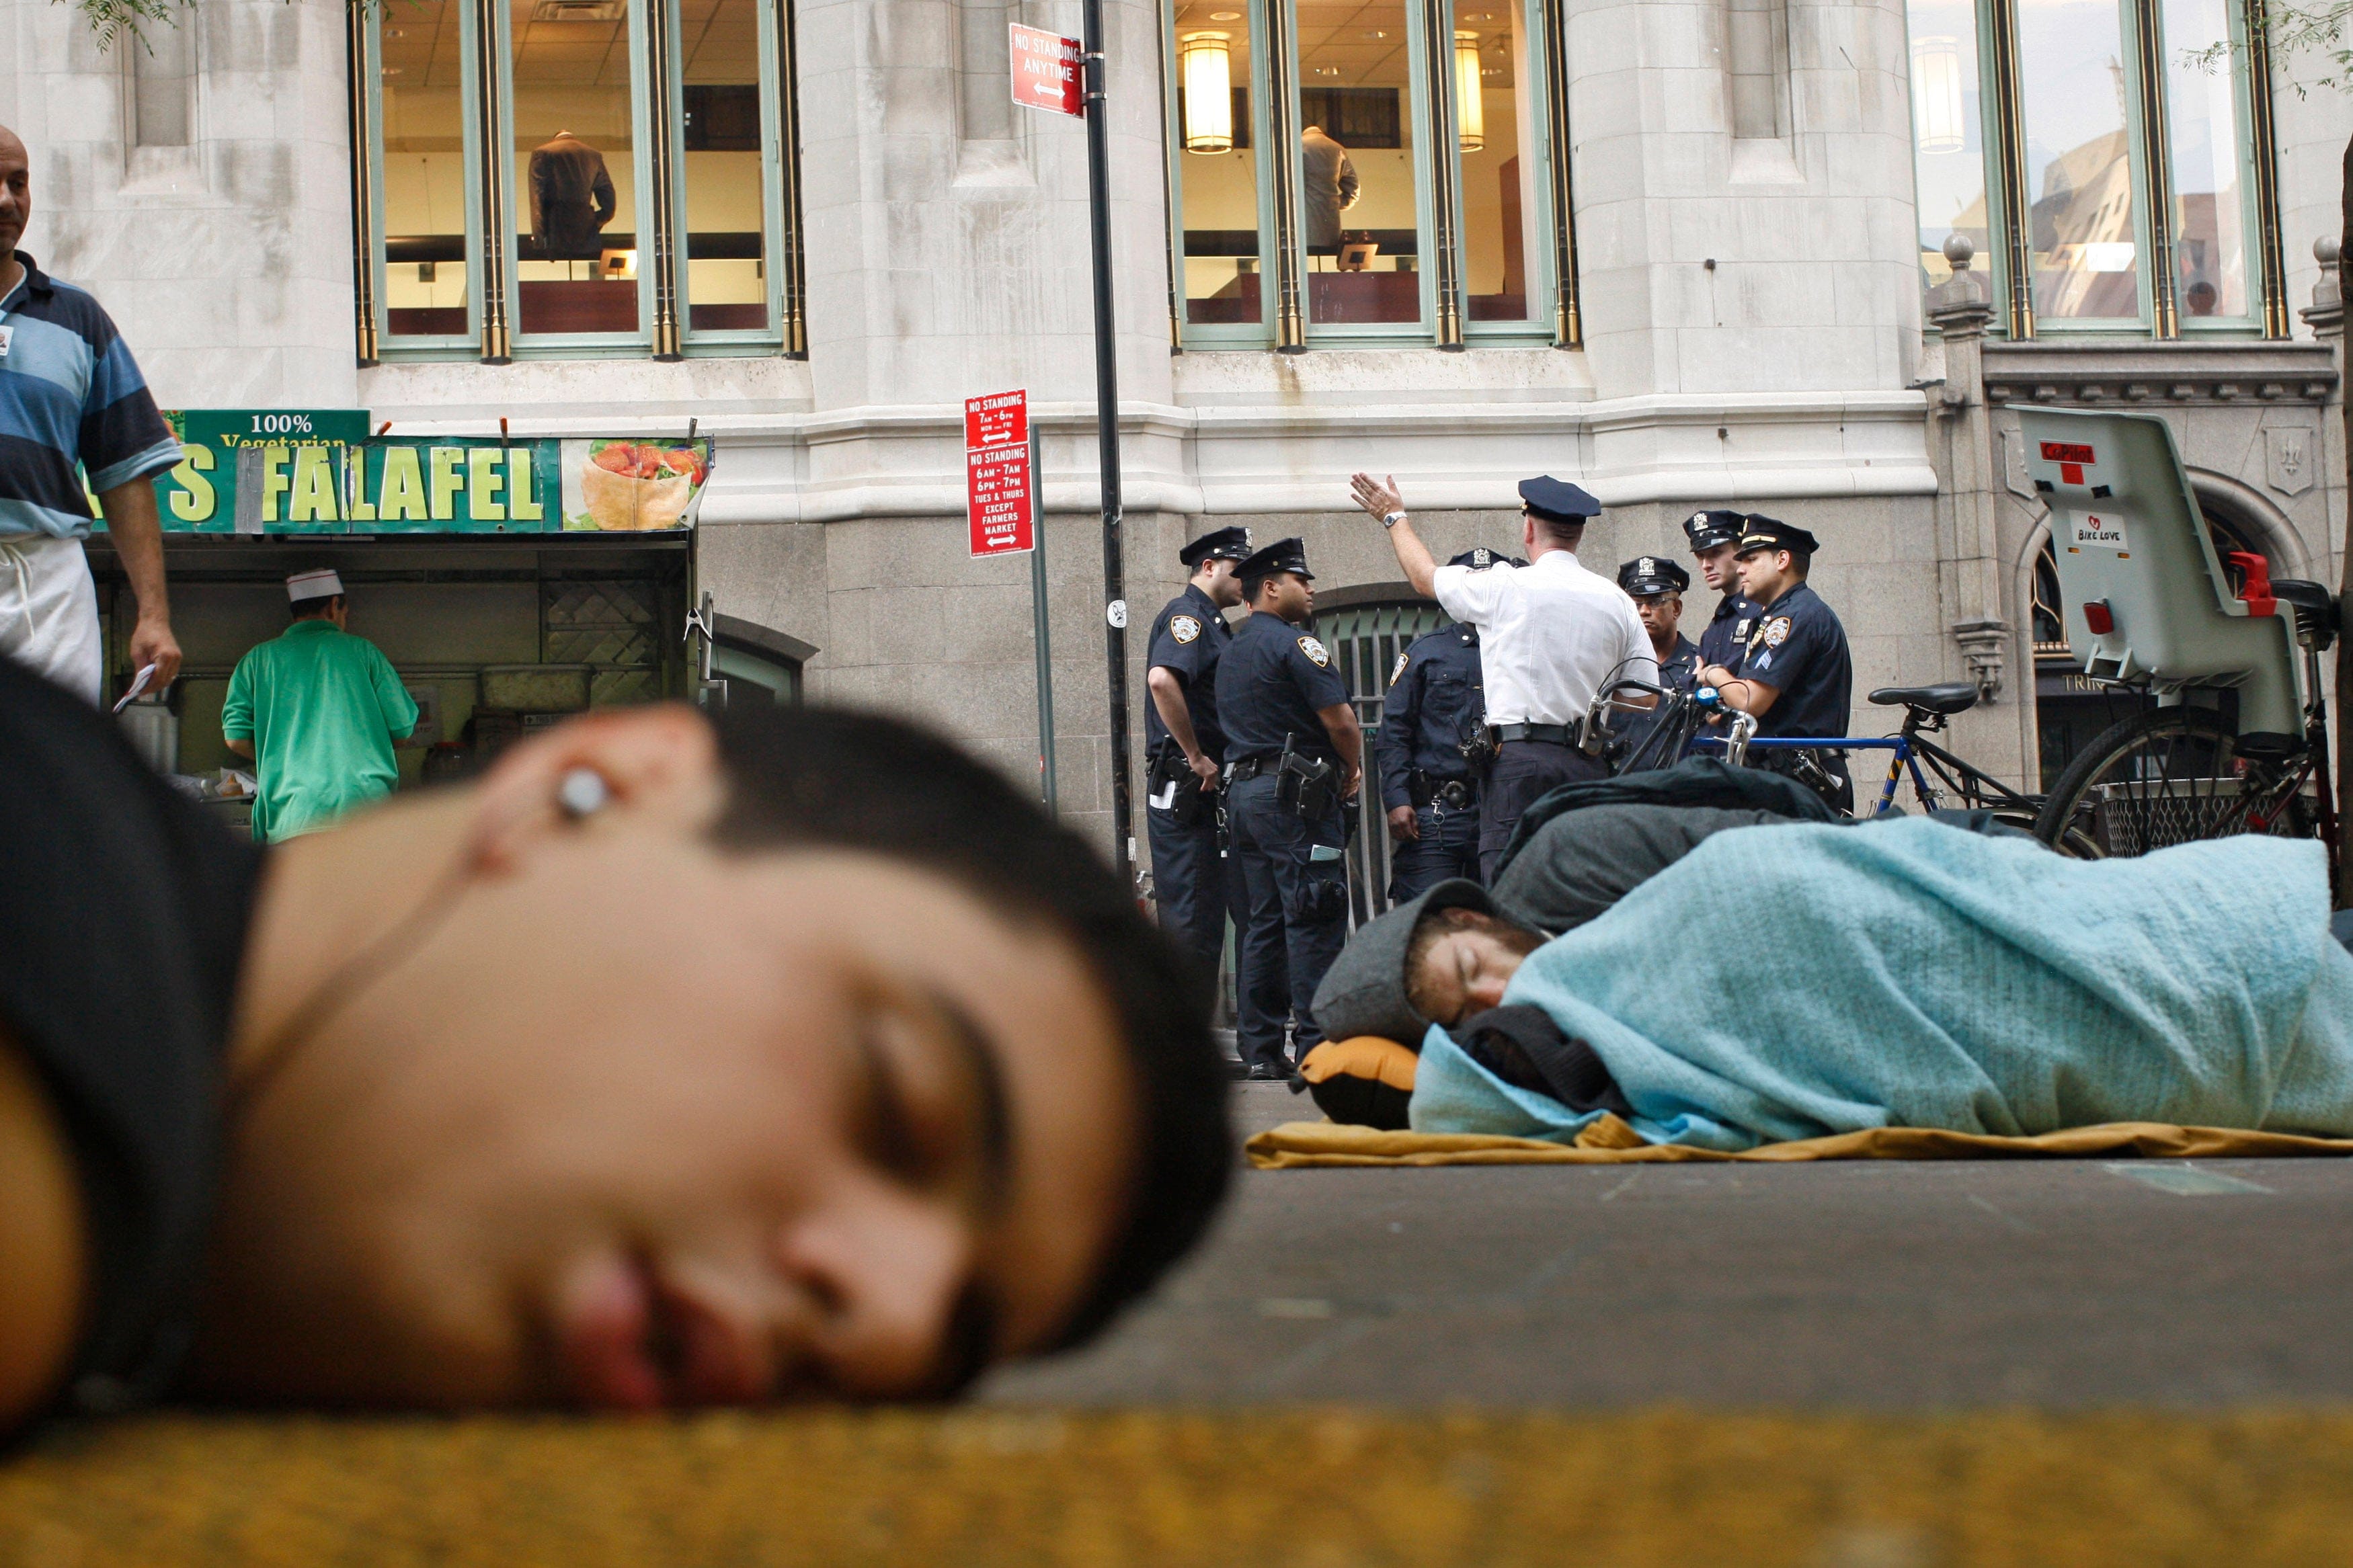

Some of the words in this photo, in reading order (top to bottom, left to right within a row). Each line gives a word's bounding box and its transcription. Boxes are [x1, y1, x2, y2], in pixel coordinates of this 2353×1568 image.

[1014, 32, 1029, 50] NO
[1033, 38, 1080, 63] STANDING
[1024, 56, 1074, 82] ANYTIME
[969, 401, 980, 413] NO
[982, 394, 1022, 411] STANDING
[251, 414, 313, 434] 100%
[970, 454, 982, 466] NO
[985, 447, 1025, 464] STANDING
[976, 468, 995, 479] 6AM
[1002, 464, 1021, 474] 7AM
[263, 446, 543, 521] FALAFEL
[977, 481, 995, 491] 6PM
[1002, 477, 1021, 488] 7PM
[974, 493, 992, 504] TUES
[994, 493, 1000, 501] &
[1002, 489, 1024, 500] THURS
[985, 502, 1014, 514] EXCEPT
[982, 512, 1019, 525] FARMERS
[985, 523, 1016, 535] MARKET
[2078, 530, 2098, 541] BIKE
[2100, 532, 2120, 541] LOVE
